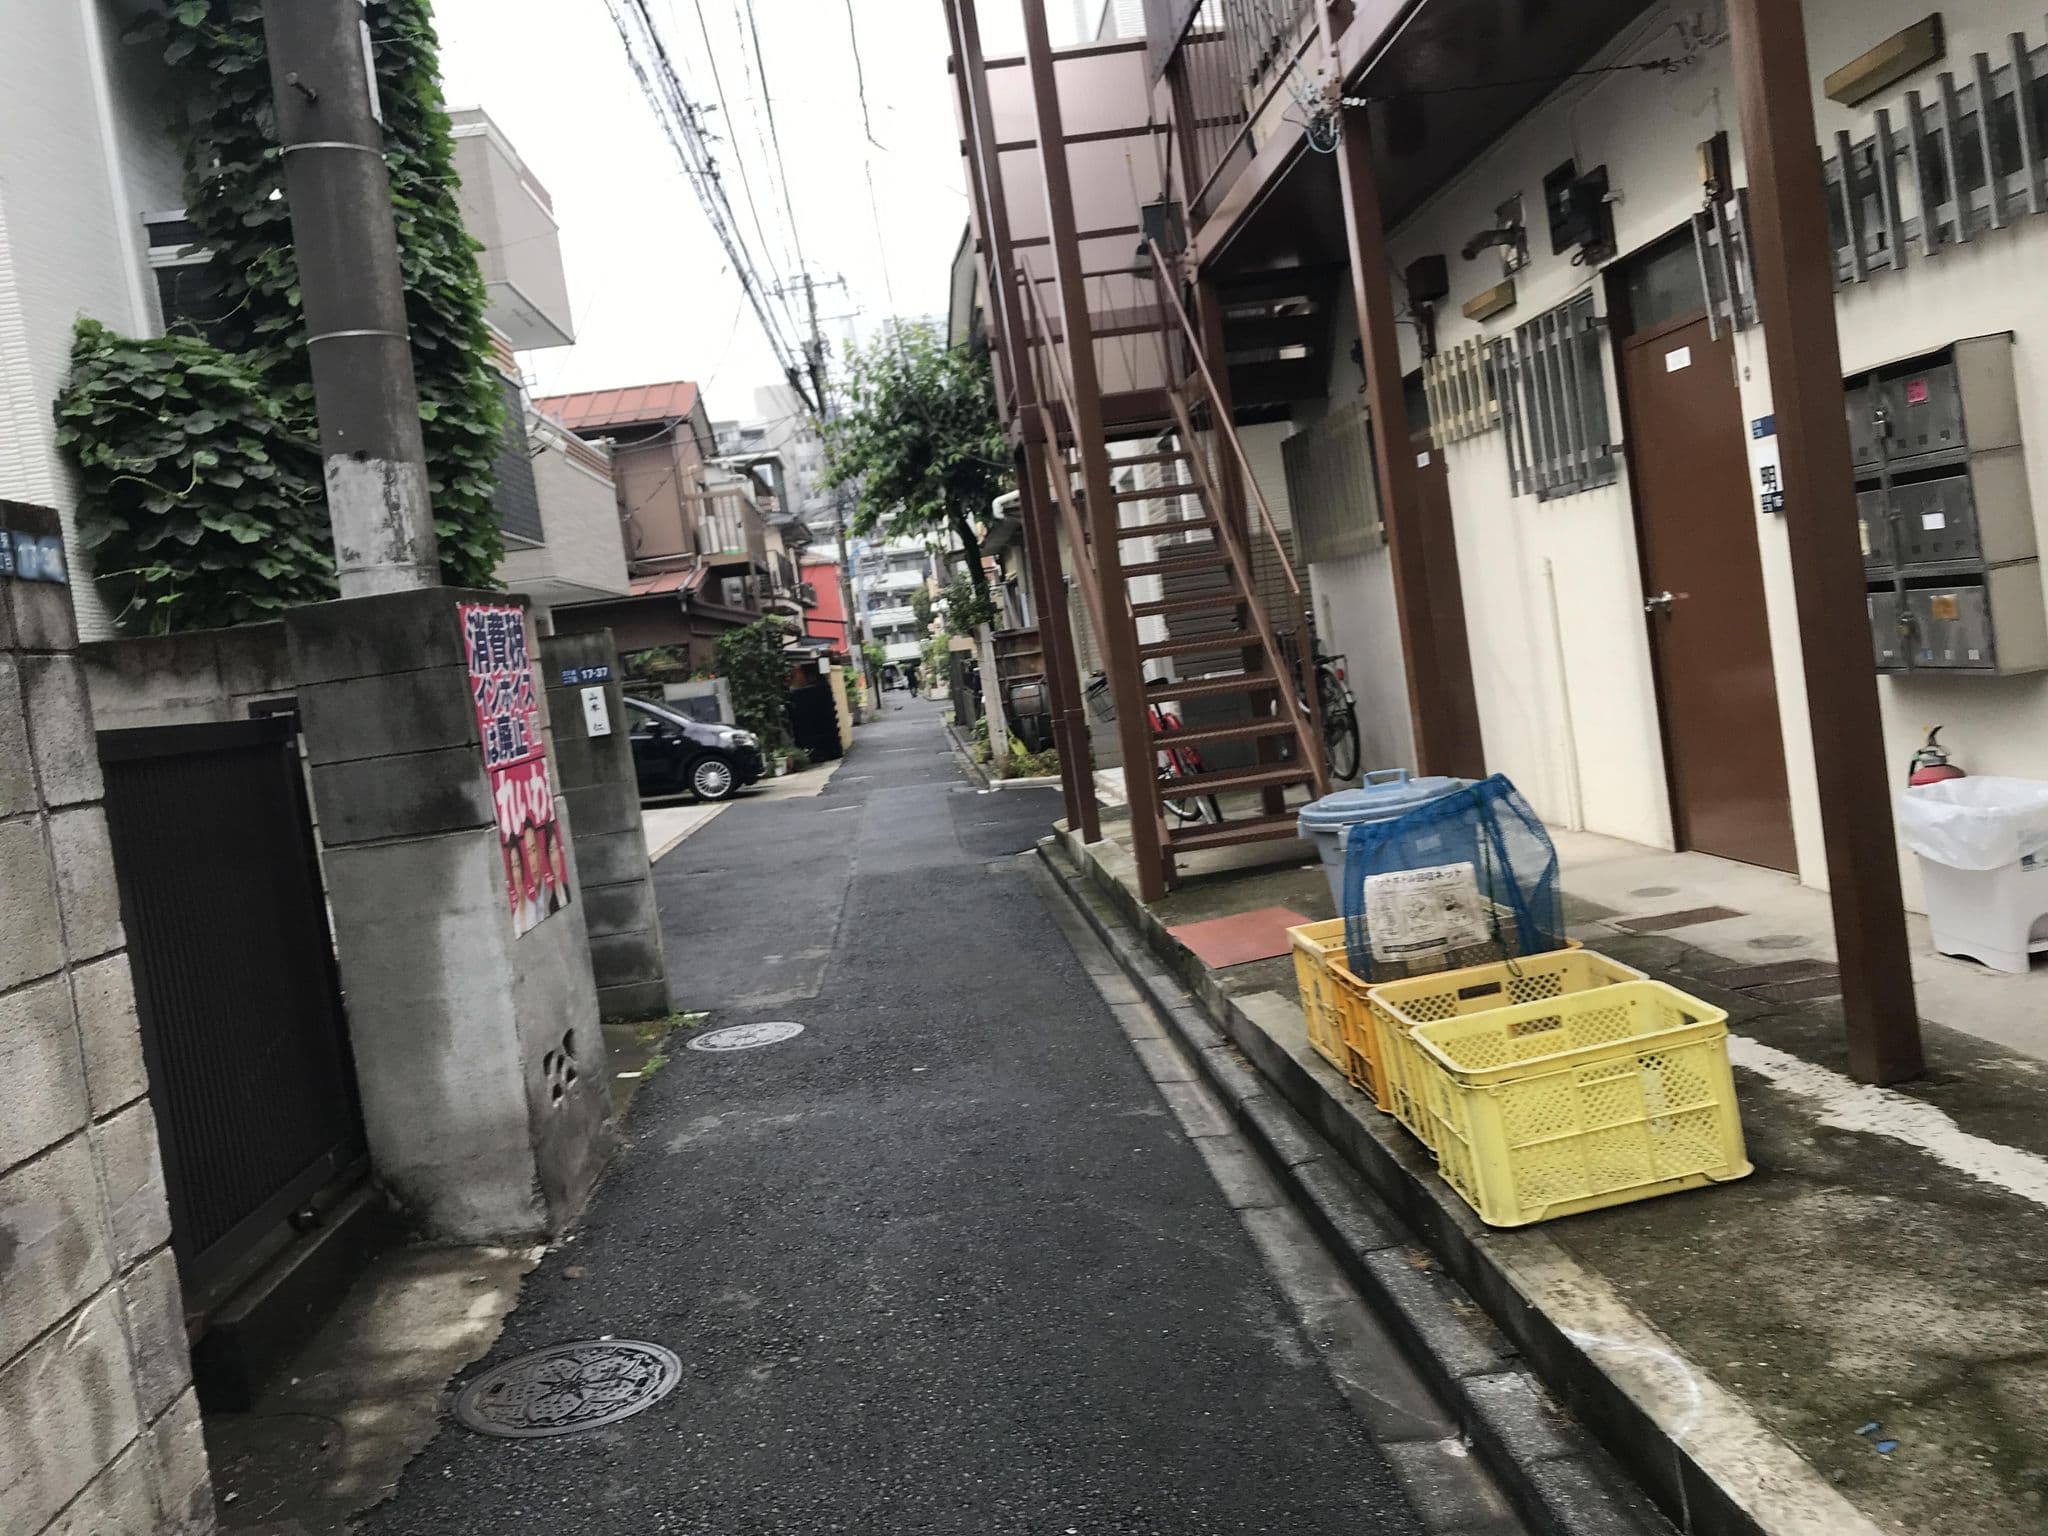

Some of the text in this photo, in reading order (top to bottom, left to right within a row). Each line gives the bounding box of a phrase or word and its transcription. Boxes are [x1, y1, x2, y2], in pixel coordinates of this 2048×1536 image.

[466, 609, 529, 677] 消費税
[475, 673, 535, 720] インボイス
[581, 667, 609, 680] 17-37
[496, 757, 556, 843] れいわ
